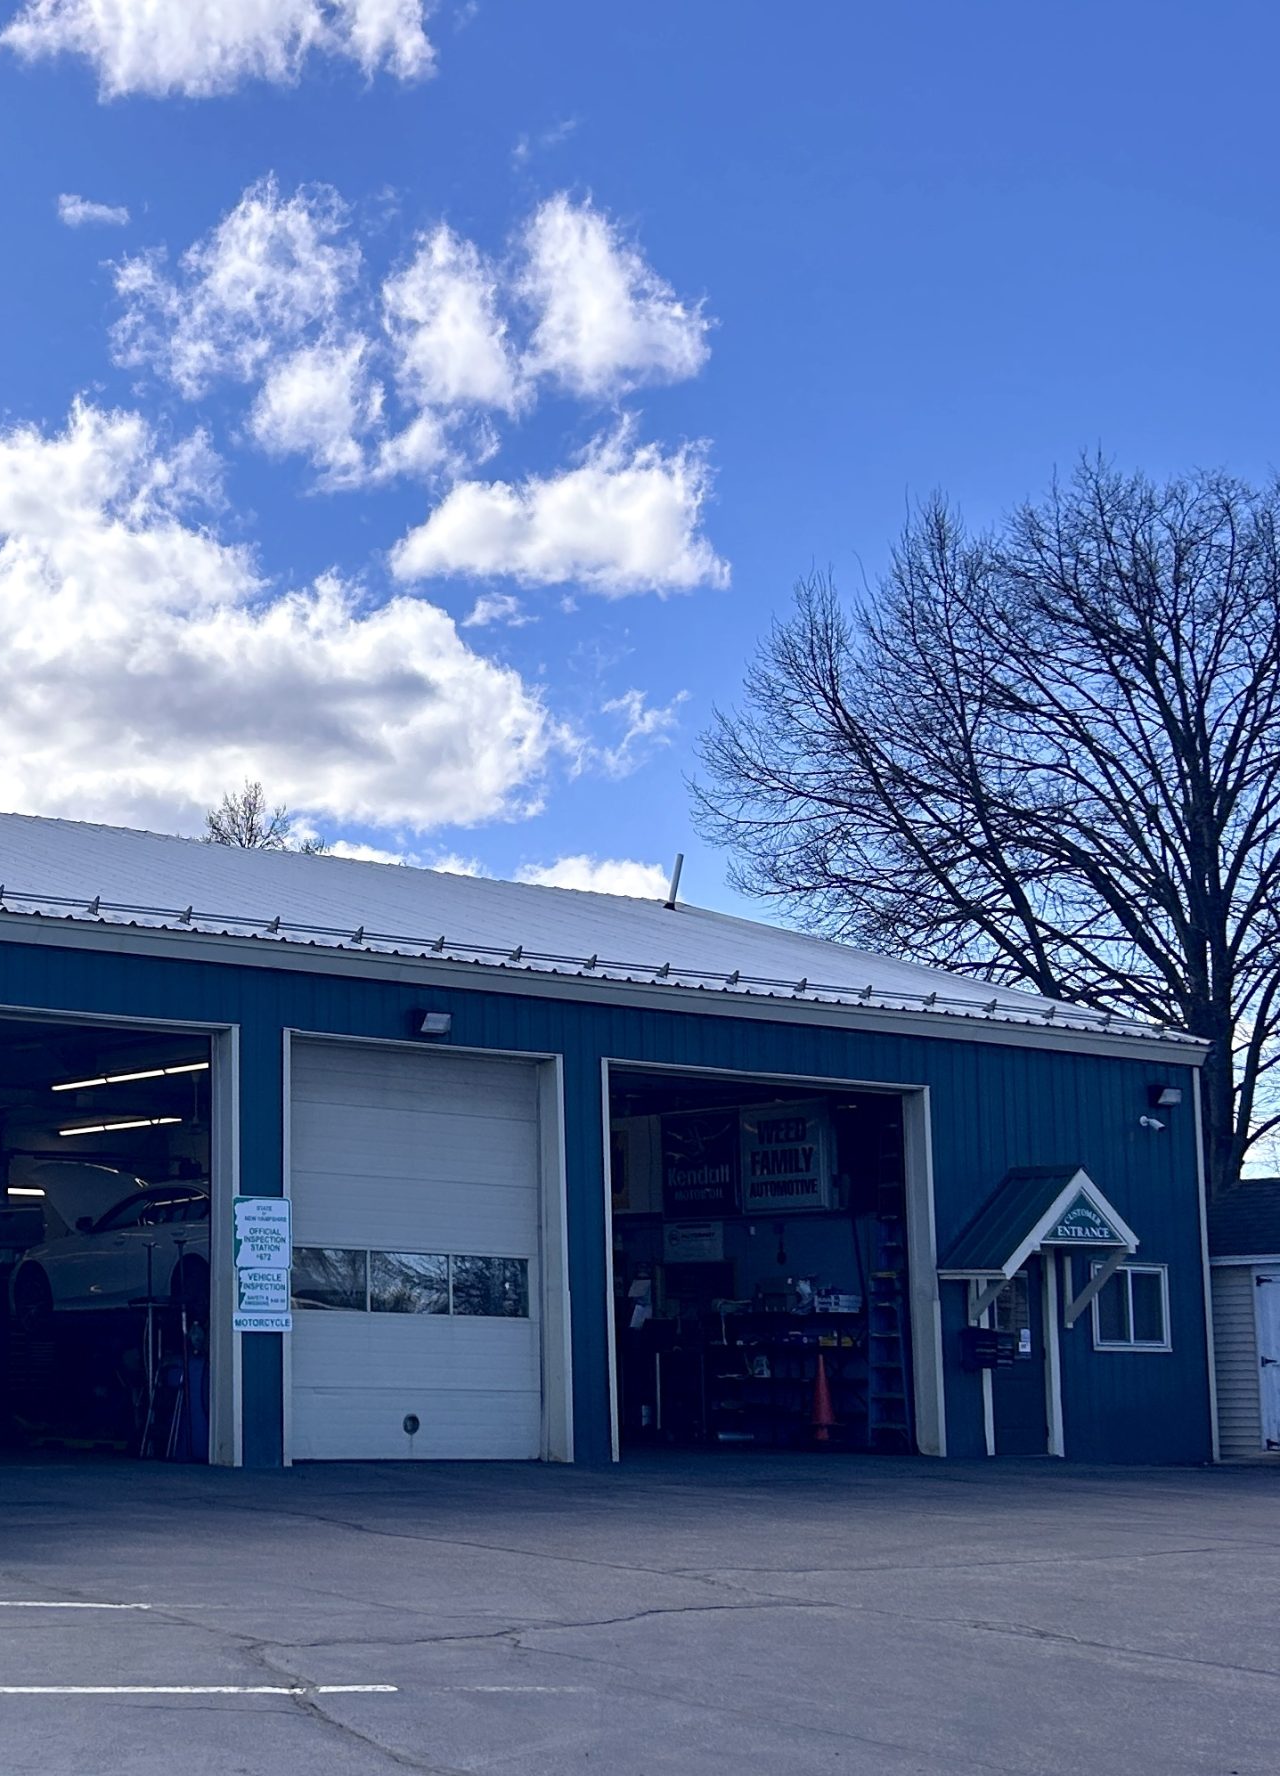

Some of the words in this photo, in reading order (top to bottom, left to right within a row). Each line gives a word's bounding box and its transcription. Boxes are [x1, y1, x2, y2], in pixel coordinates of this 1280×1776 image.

[758, 1117, 807, 1145] WEED
[750, 1147, 814, 1176] FAMILY
[667, 1164, 730, 1187] Kendall
[749, 1178, 818, 1199] AUTOMOTIVE
[1063, 1208, 1102, 1226] CUSTOMER
[249, 1227, 281, 1236] OFFICIAL
[1057, 1225, 1110, 1238] ENTRANCE
[244, 1235, 286, 1244] INSPECTION
[250, 1243, 281, 1252] STATION
[247, 1273, 282, 1282] VEHICLE
[243, 1282, 286, 1291] INSPECTION
[234, 1318, 290, 1328] MOTORCYCLE
